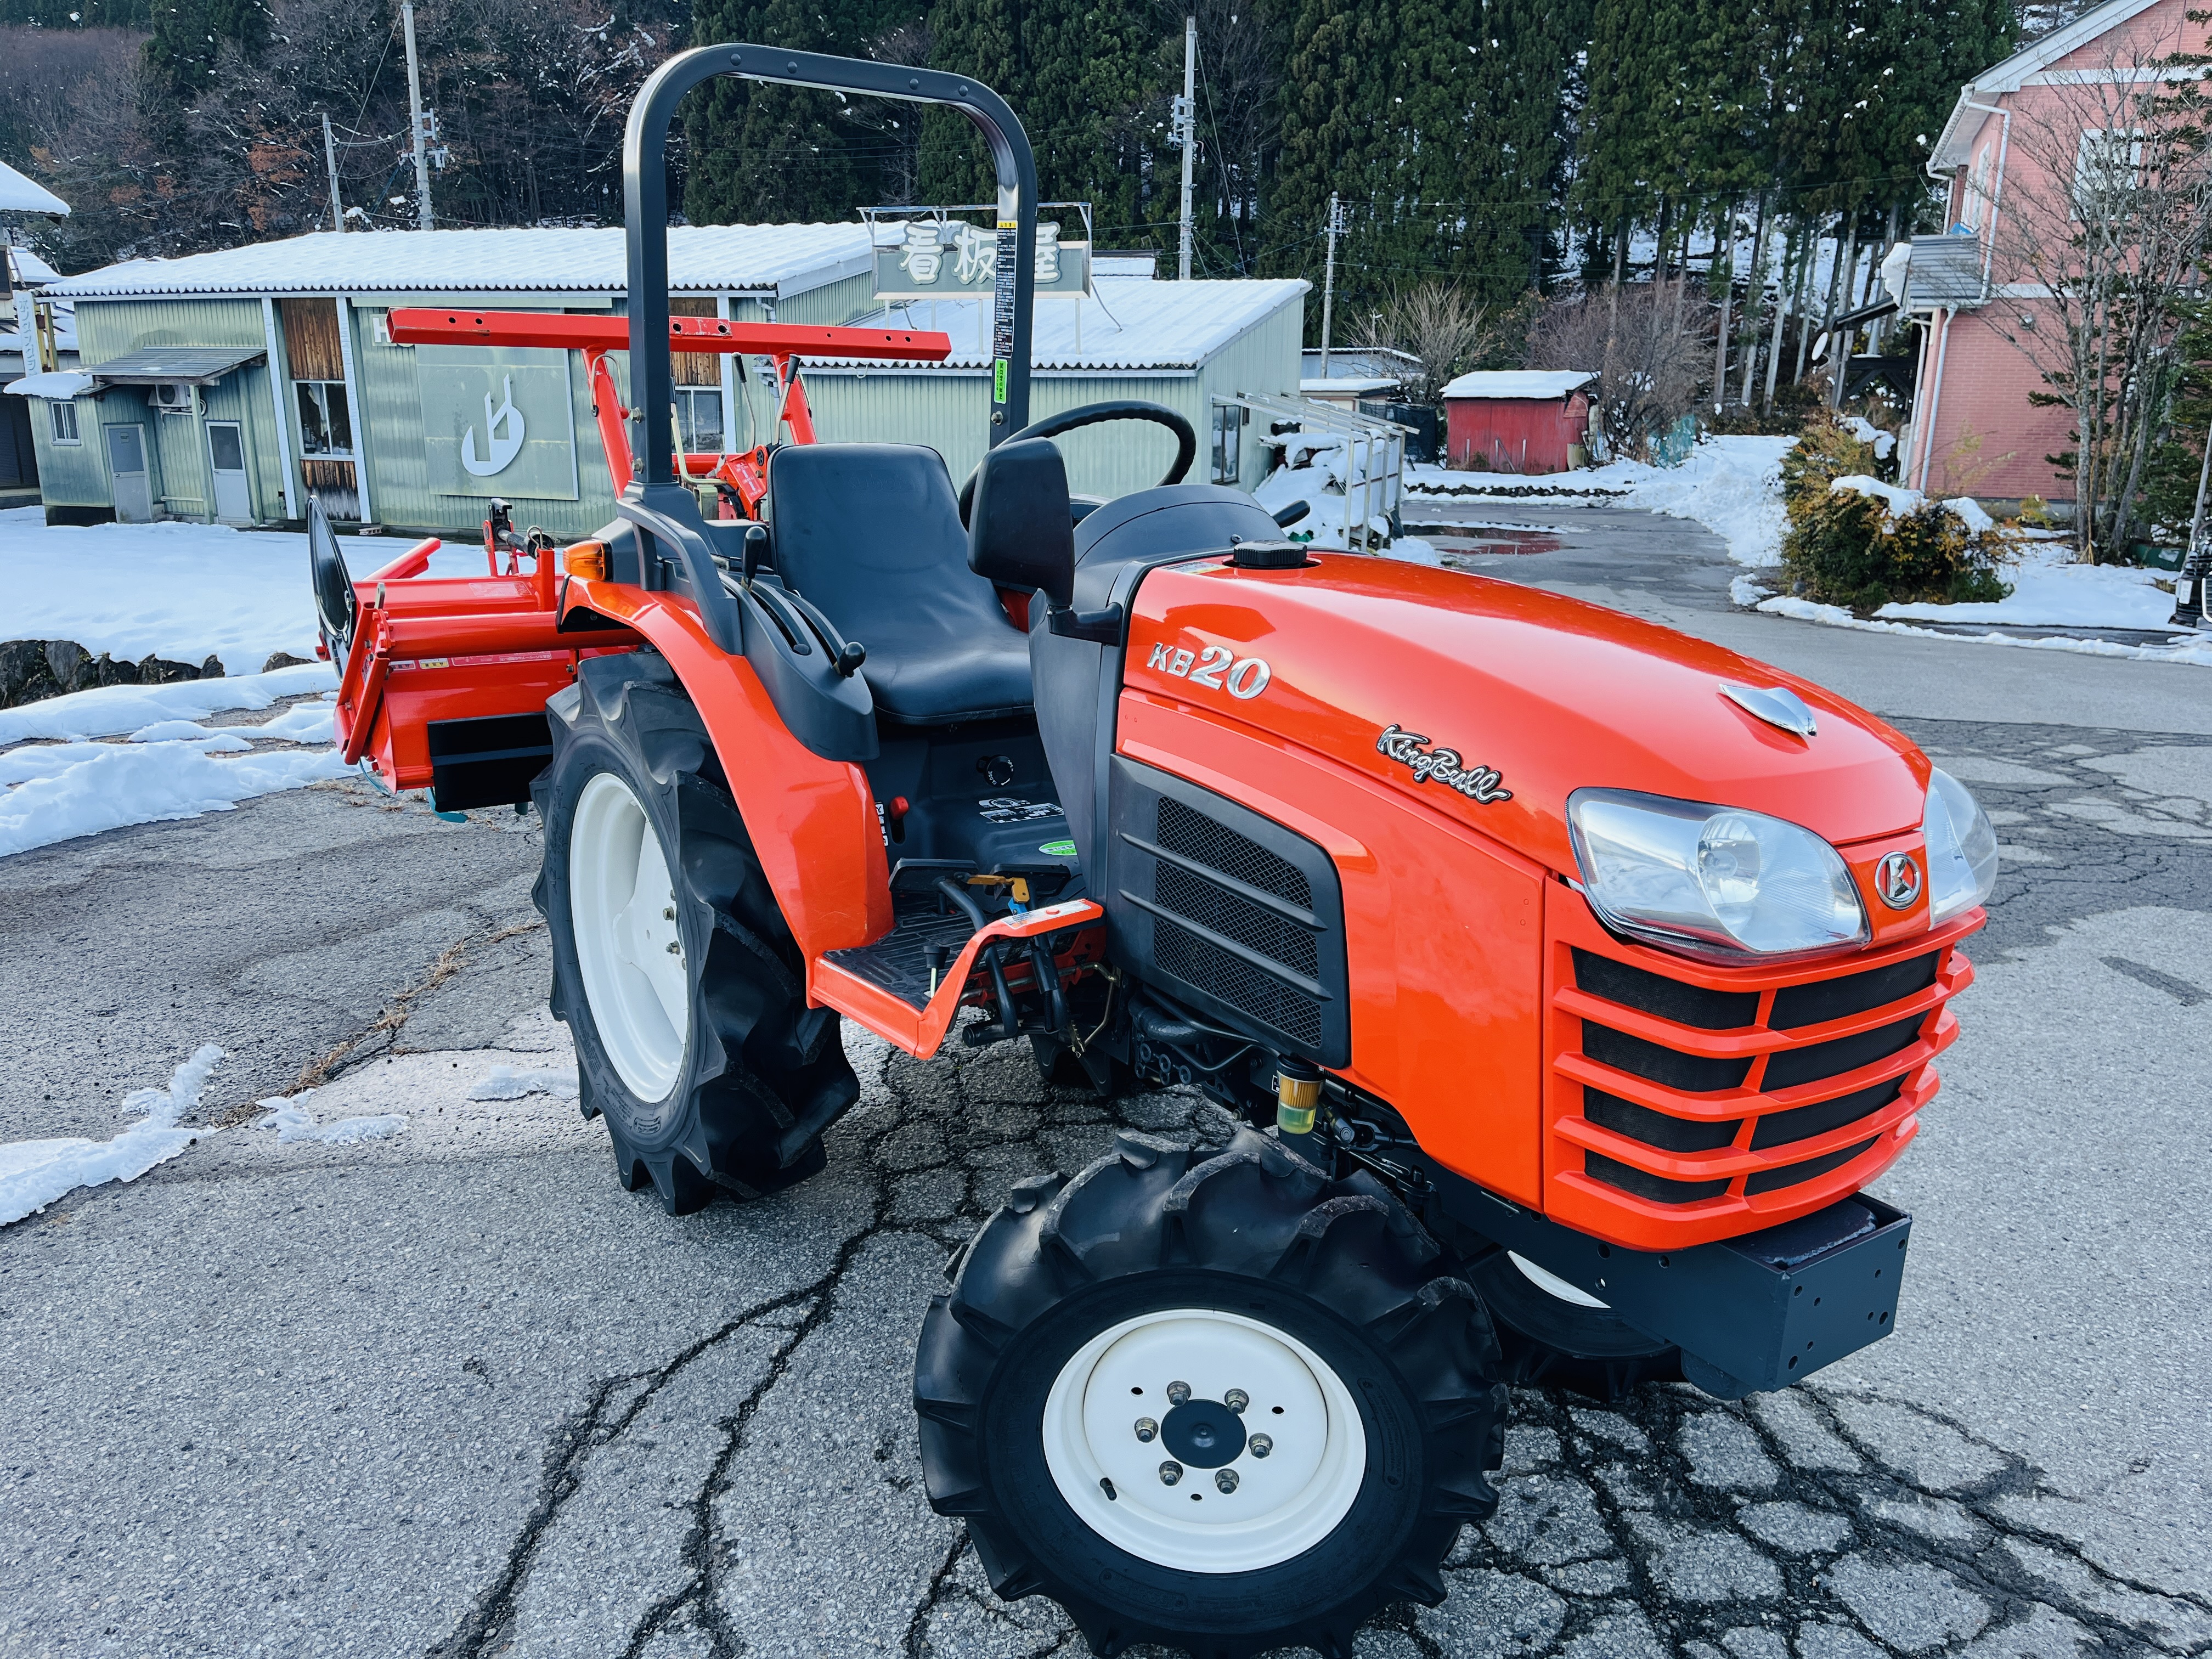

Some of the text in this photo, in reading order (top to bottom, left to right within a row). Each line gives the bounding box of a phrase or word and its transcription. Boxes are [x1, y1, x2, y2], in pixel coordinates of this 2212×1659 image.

[1147, 642, 1272, 699] KB20
[988, 770, 997, 785] CLOSE
[1376, 724, 1514, 805] KingBull
